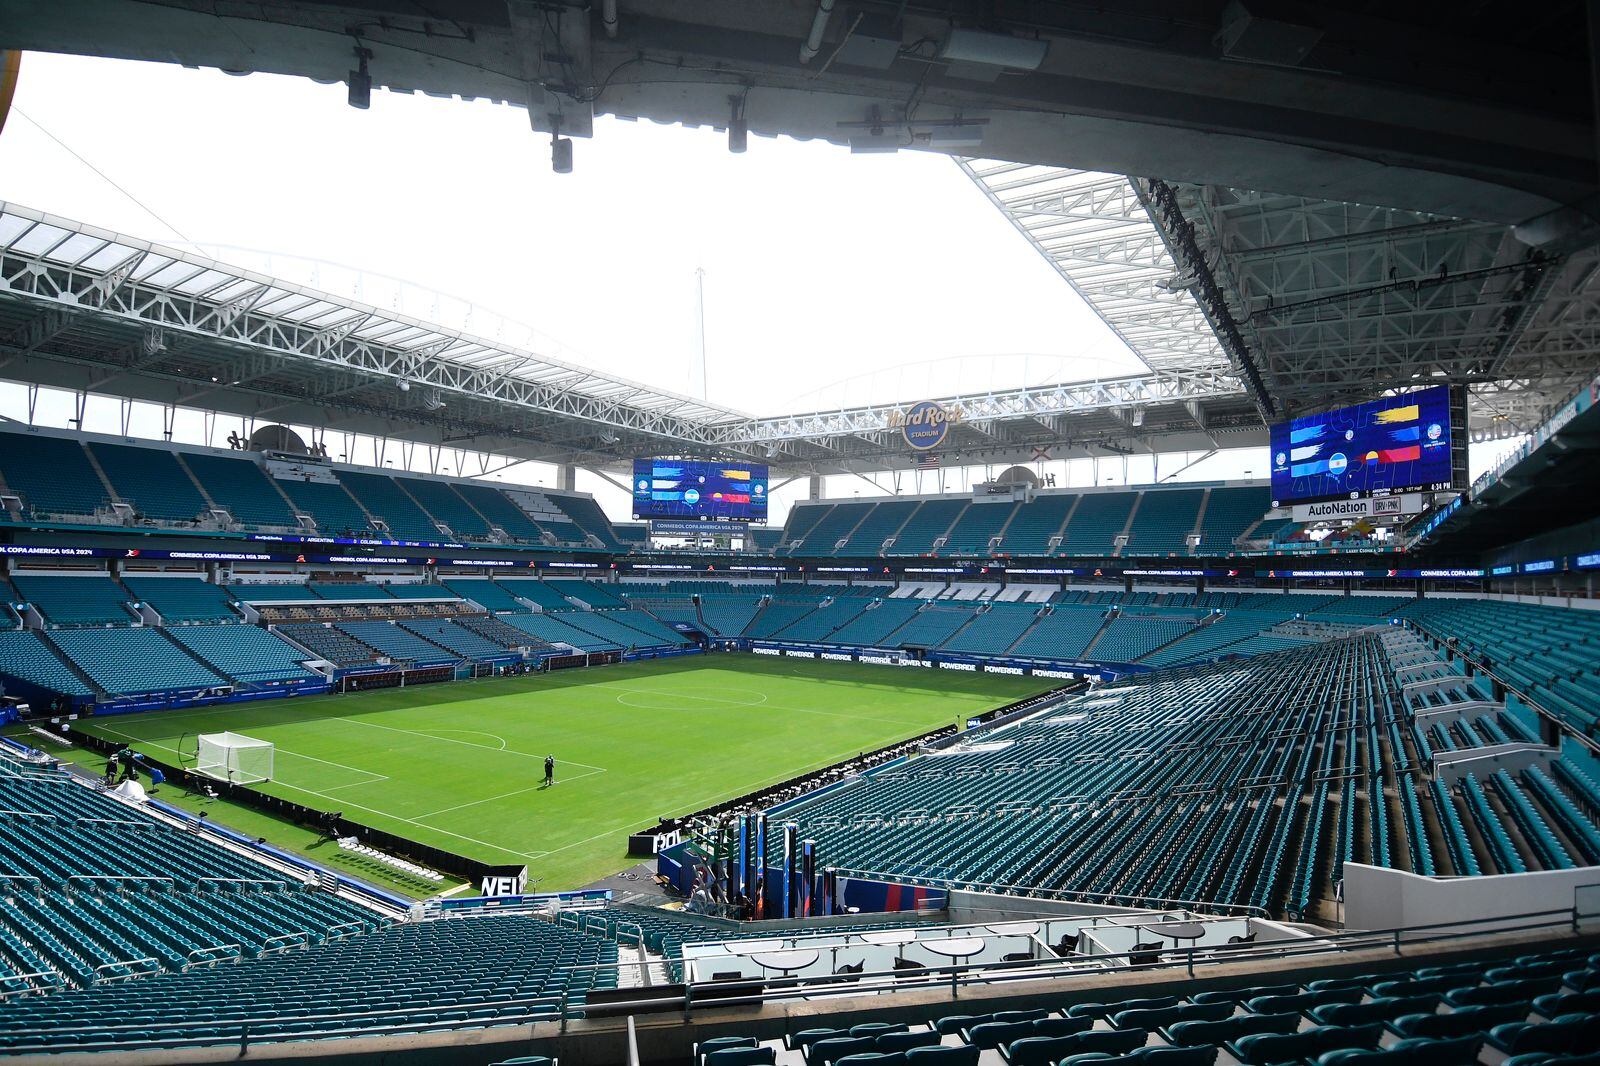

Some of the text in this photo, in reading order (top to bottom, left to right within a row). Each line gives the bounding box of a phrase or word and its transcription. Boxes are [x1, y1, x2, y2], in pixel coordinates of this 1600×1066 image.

[887, 403, 963, 428] Hard Rock
[1308, 501, 1368, 517] AutoNation
[7, 546, 28, 554] COPA
[28, 547, 60, 555] AMERICA
[753, 648, 781, 656] POWERADE
[786, 650, 815, 659] POWERADE
[821, 652, 852, 661] POWERADE
[858, 655, 892, 665] POWERADE
[939, 662, 976, 672] POWERADE
[984, 665, 1024, 676] POWERADE
[1032, 669, 1074, 680] POWERADE
